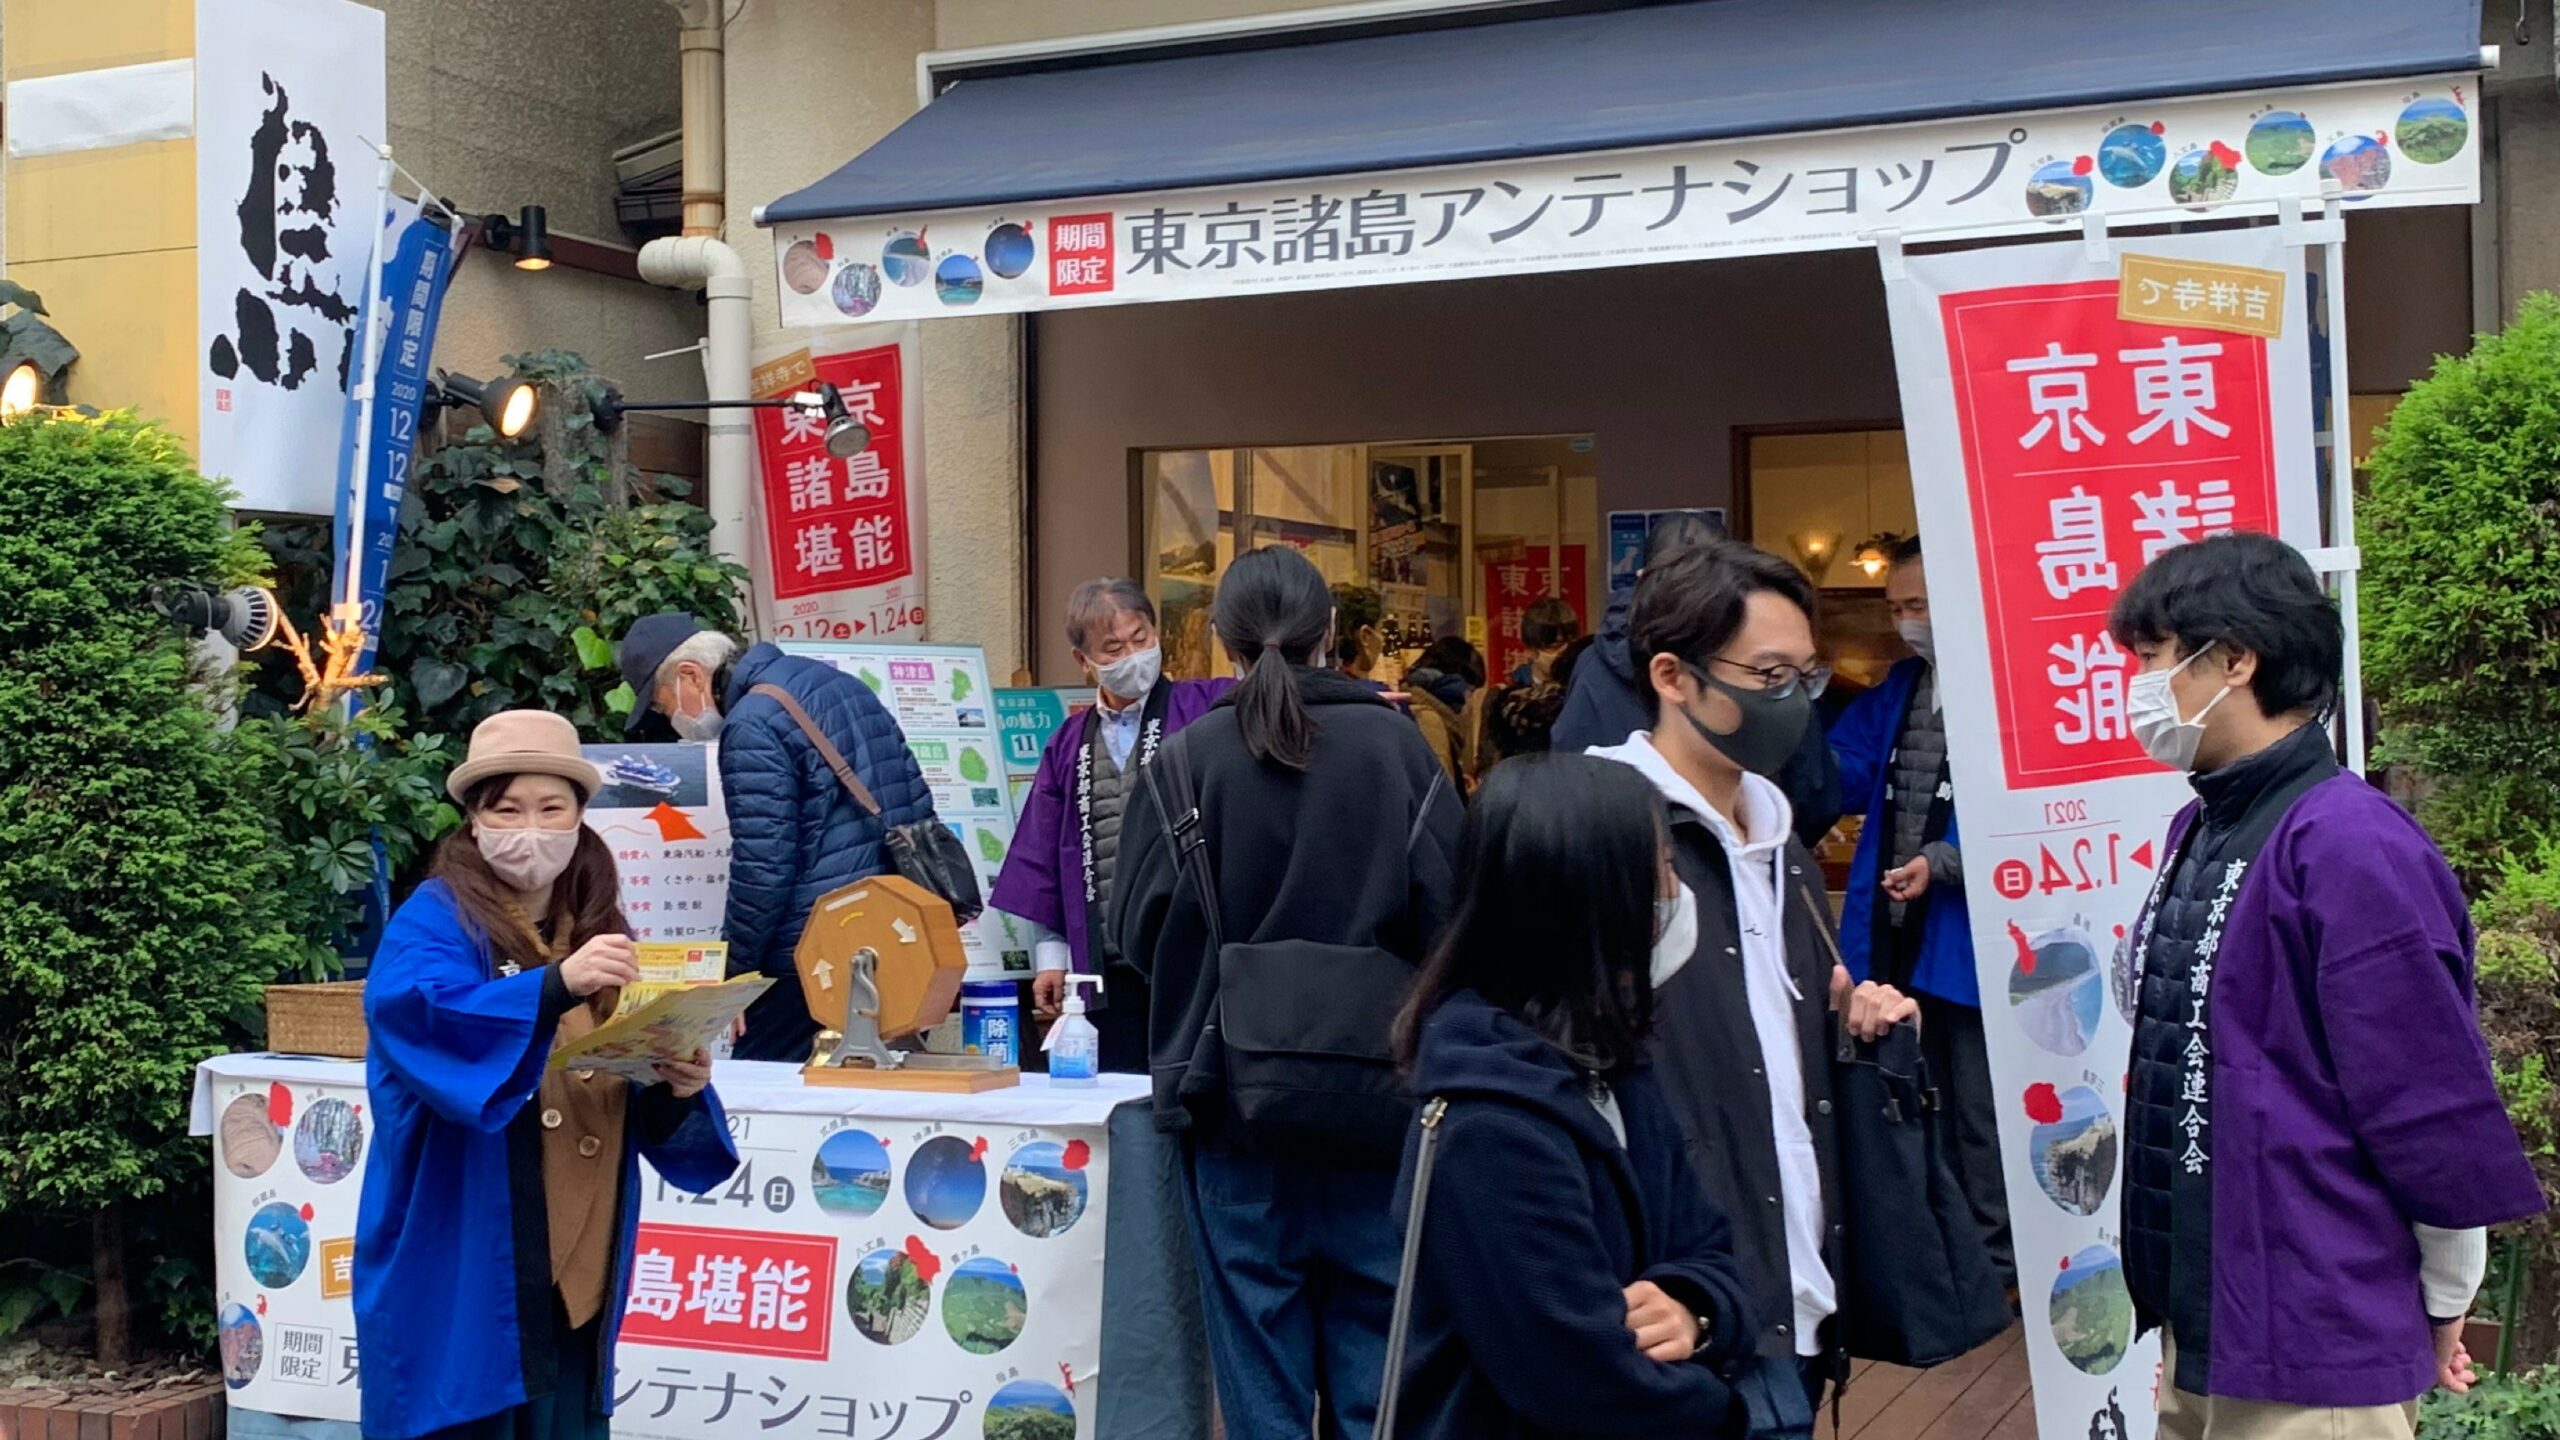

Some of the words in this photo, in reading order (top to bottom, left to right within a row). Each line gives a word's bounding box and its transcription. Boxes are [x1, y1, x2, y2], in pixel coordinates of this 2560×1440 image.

[1124, 127, 2028, 275] 東京諸島アンテナショップ
[1055, 223, 1106, 251] 期間
[1055, 256, 1107, 286] 限定
[391, 382, 417, 401] 2020
[390, 407, 413, 440] 12
[387, 449, 407, 482] 12
[786, 451, 891, 512] 諸島
[794, 515, 894, 577] 堪能
[793, 601, 818, 616] 2020
[2178, 858, 2248, 1175] 東京都商工会連合会
[624, 1248, 812, 1332] 島堪能
[283, 1330, 324, 1355] 期間
[280, 1355, 322, 1380] 限定
